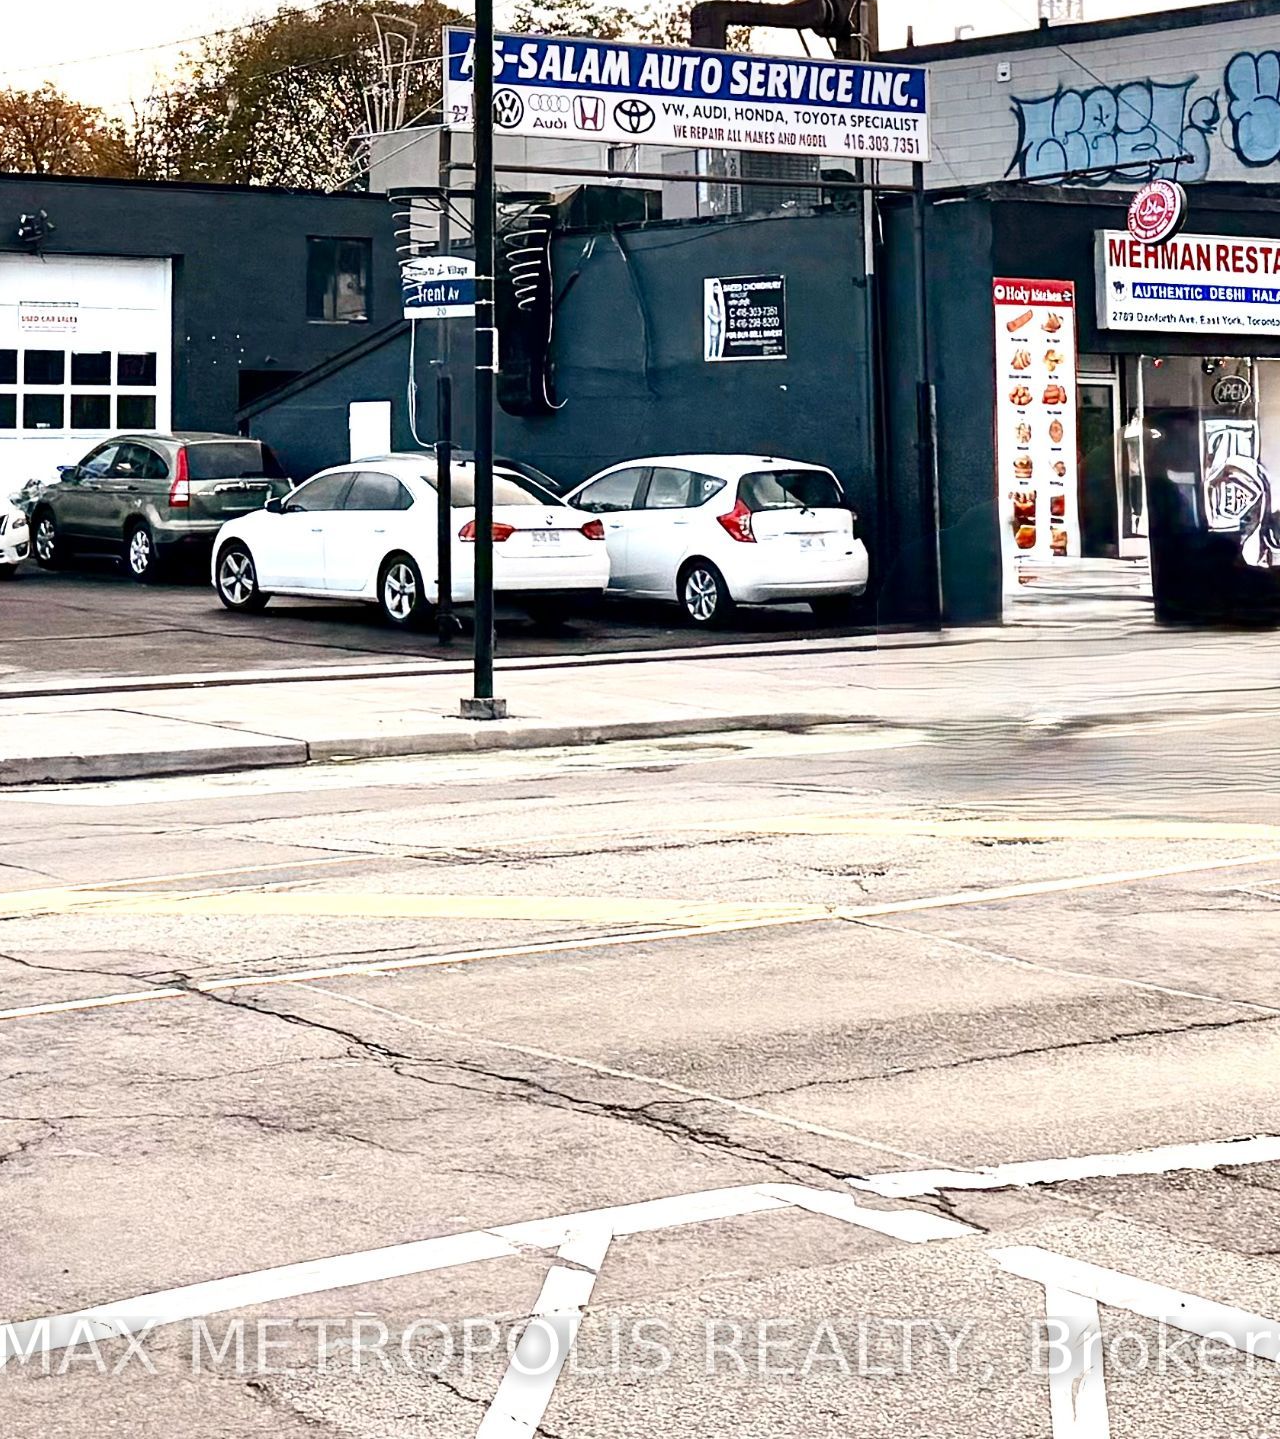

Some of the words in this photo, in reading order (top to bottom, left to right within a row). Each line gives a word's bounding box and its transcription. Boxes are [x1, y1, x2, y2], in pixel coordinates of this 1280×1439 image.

[460, 38, 630, 87] AS-SALAM
[638, 53, 723, 94] AUTO
[730, 60, 853, 103] SERVICE
[861, 70, 918, 108] INC.
[532, 117, 567, 129] Audi
[693, 104, 730, 121] AUDI,
[735, 107, 788, 125] HONDA,
[794, 111, 847, 127] TOYOTA
[850, 114, 919, 132] SPECIALIST
[673, 124, 687, 138] WE
[690, 125, 724, 141] REPAIR
[727, 129, 742, 143] ALL
[745, 131, 775, 145] MAKES
[778, 132, 796, 146] AND
[799, 134, 827, 148] MODEL
[844, 133, 920, 154] 416.303.7351
[1109, 239, 1211, 272] MEHMAN
[417, 284, 445, 303] Trent
[447, 286, 460, 301] Av
[1006, 285, 1031, 304] Holy
[1133, 284, 1203, 300] AUTHENTIC
[1209, 287, 1246, 301] DESHI
[1136, 312, 1176, 323] Danforth
[1200, 315, 1220, 325] East
[1219, 382, 1247, 401] OPEN
